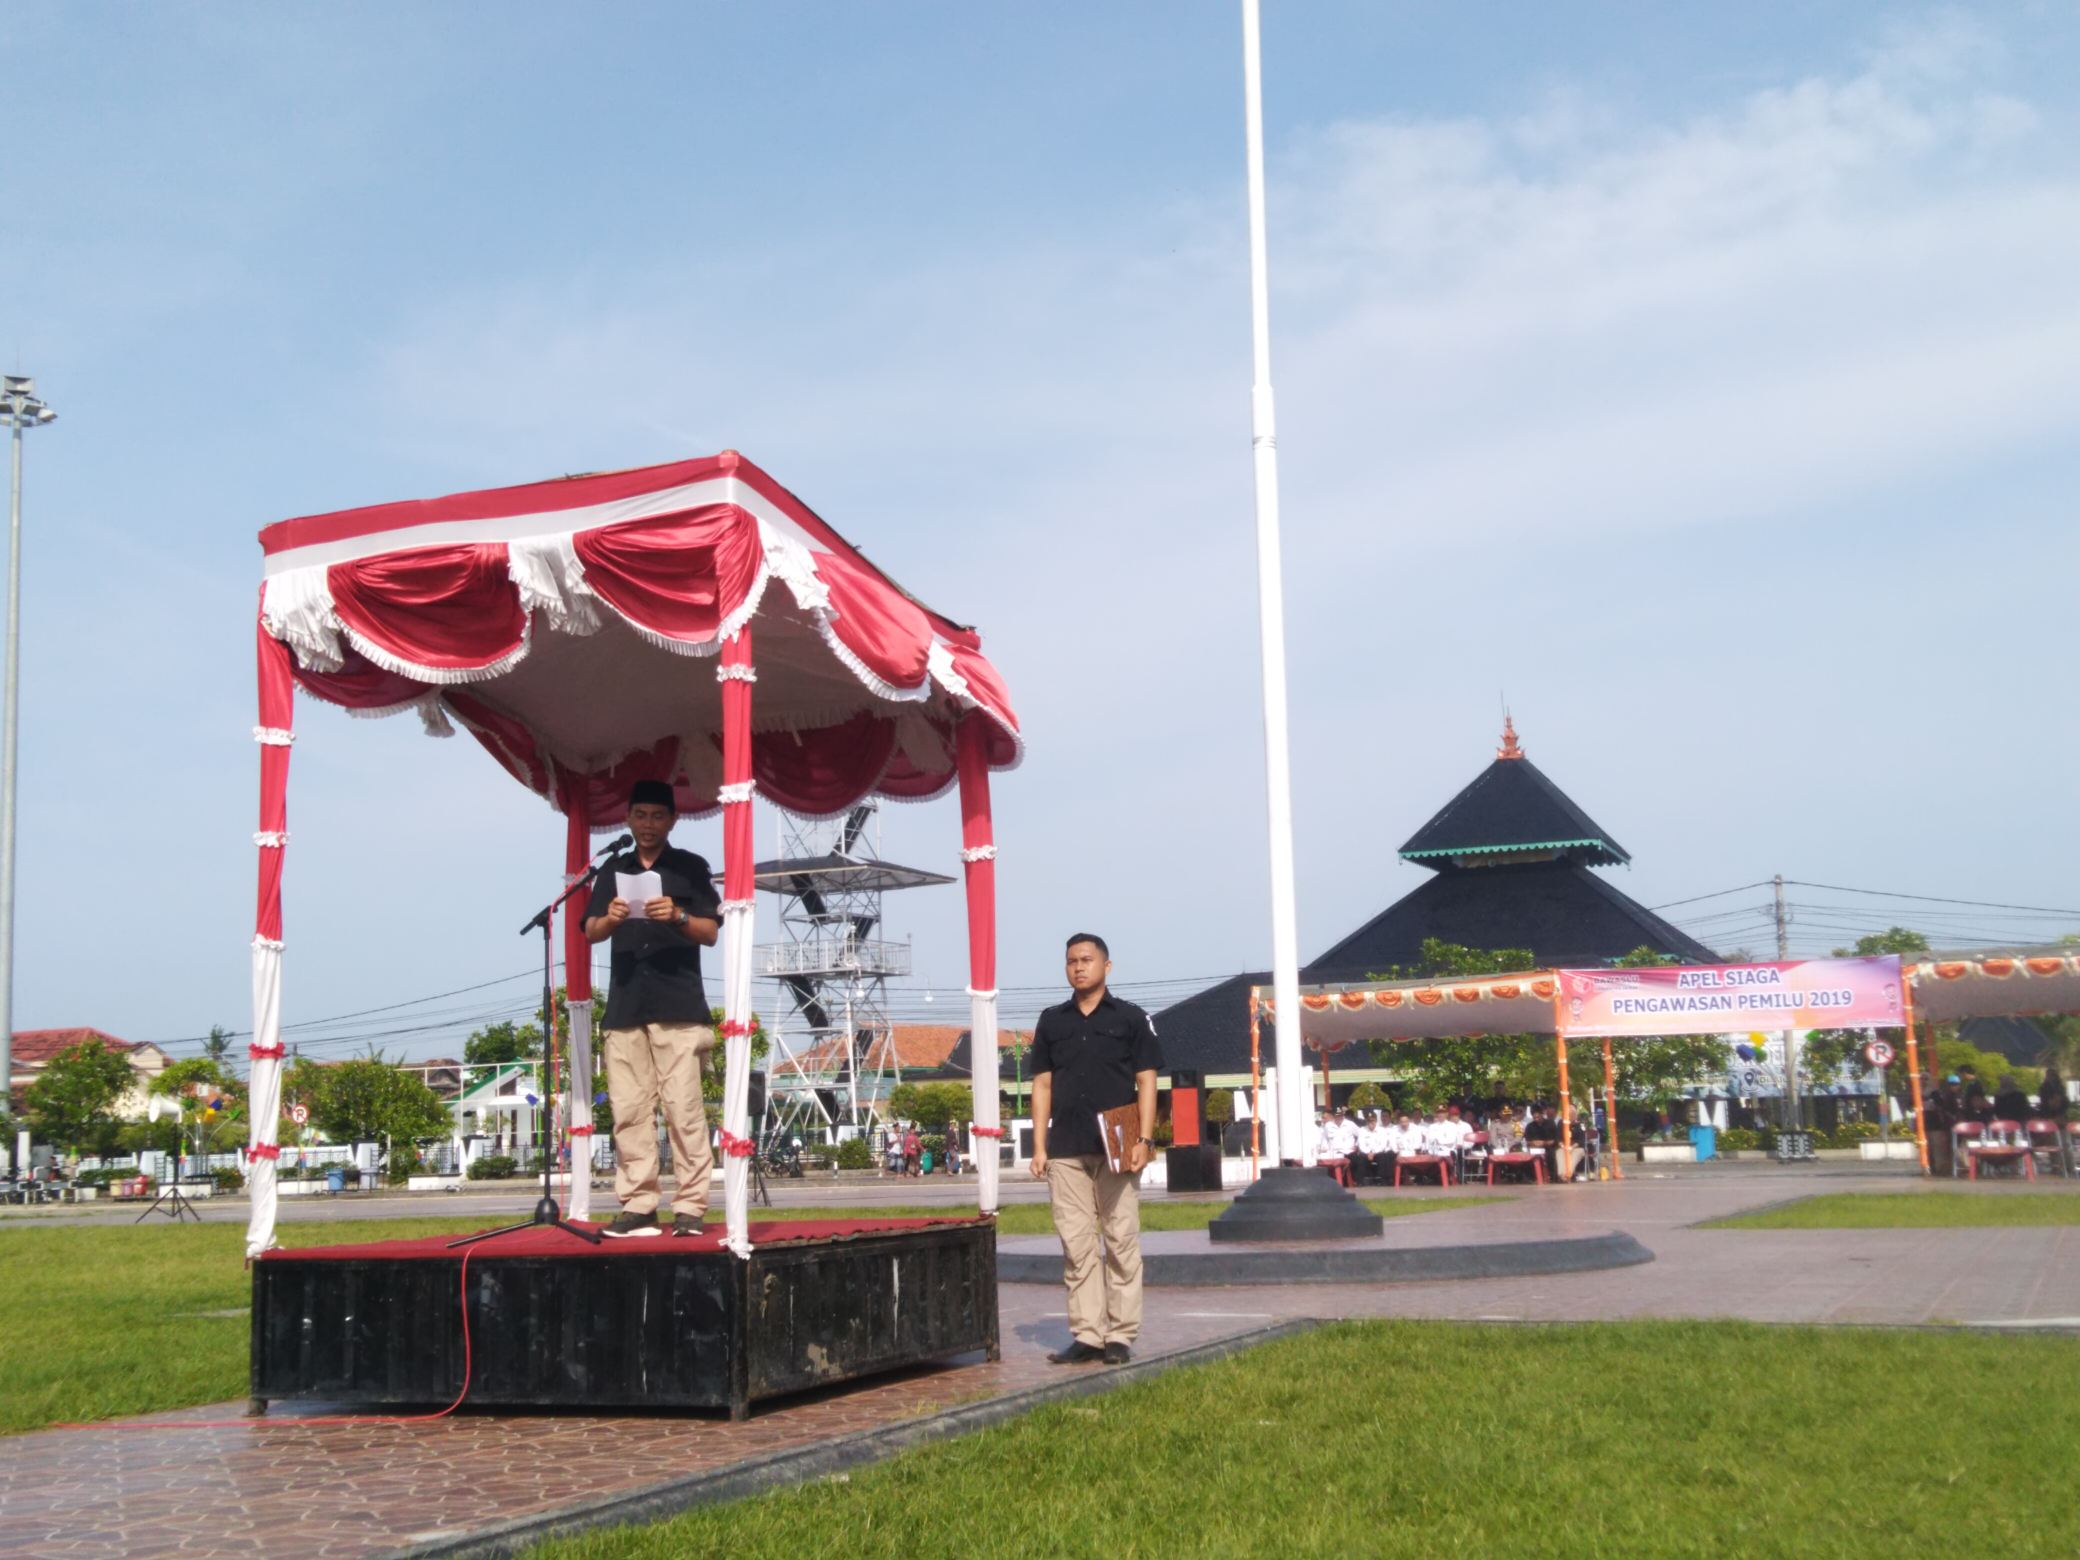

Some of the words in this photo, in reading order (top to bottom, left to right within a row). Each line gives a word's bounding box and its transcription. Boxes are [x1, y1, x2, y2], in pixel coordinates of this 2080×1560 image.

[1679, 973, 1721, 987] APEL
[1725, 969, 1780, 985] SIAGA
[1613, 996, 1732, 1013] PENGAWASAN
[1738, 993, 1803, 1008] PEMILU
[1810, 990, 1852, 1006] 2019
